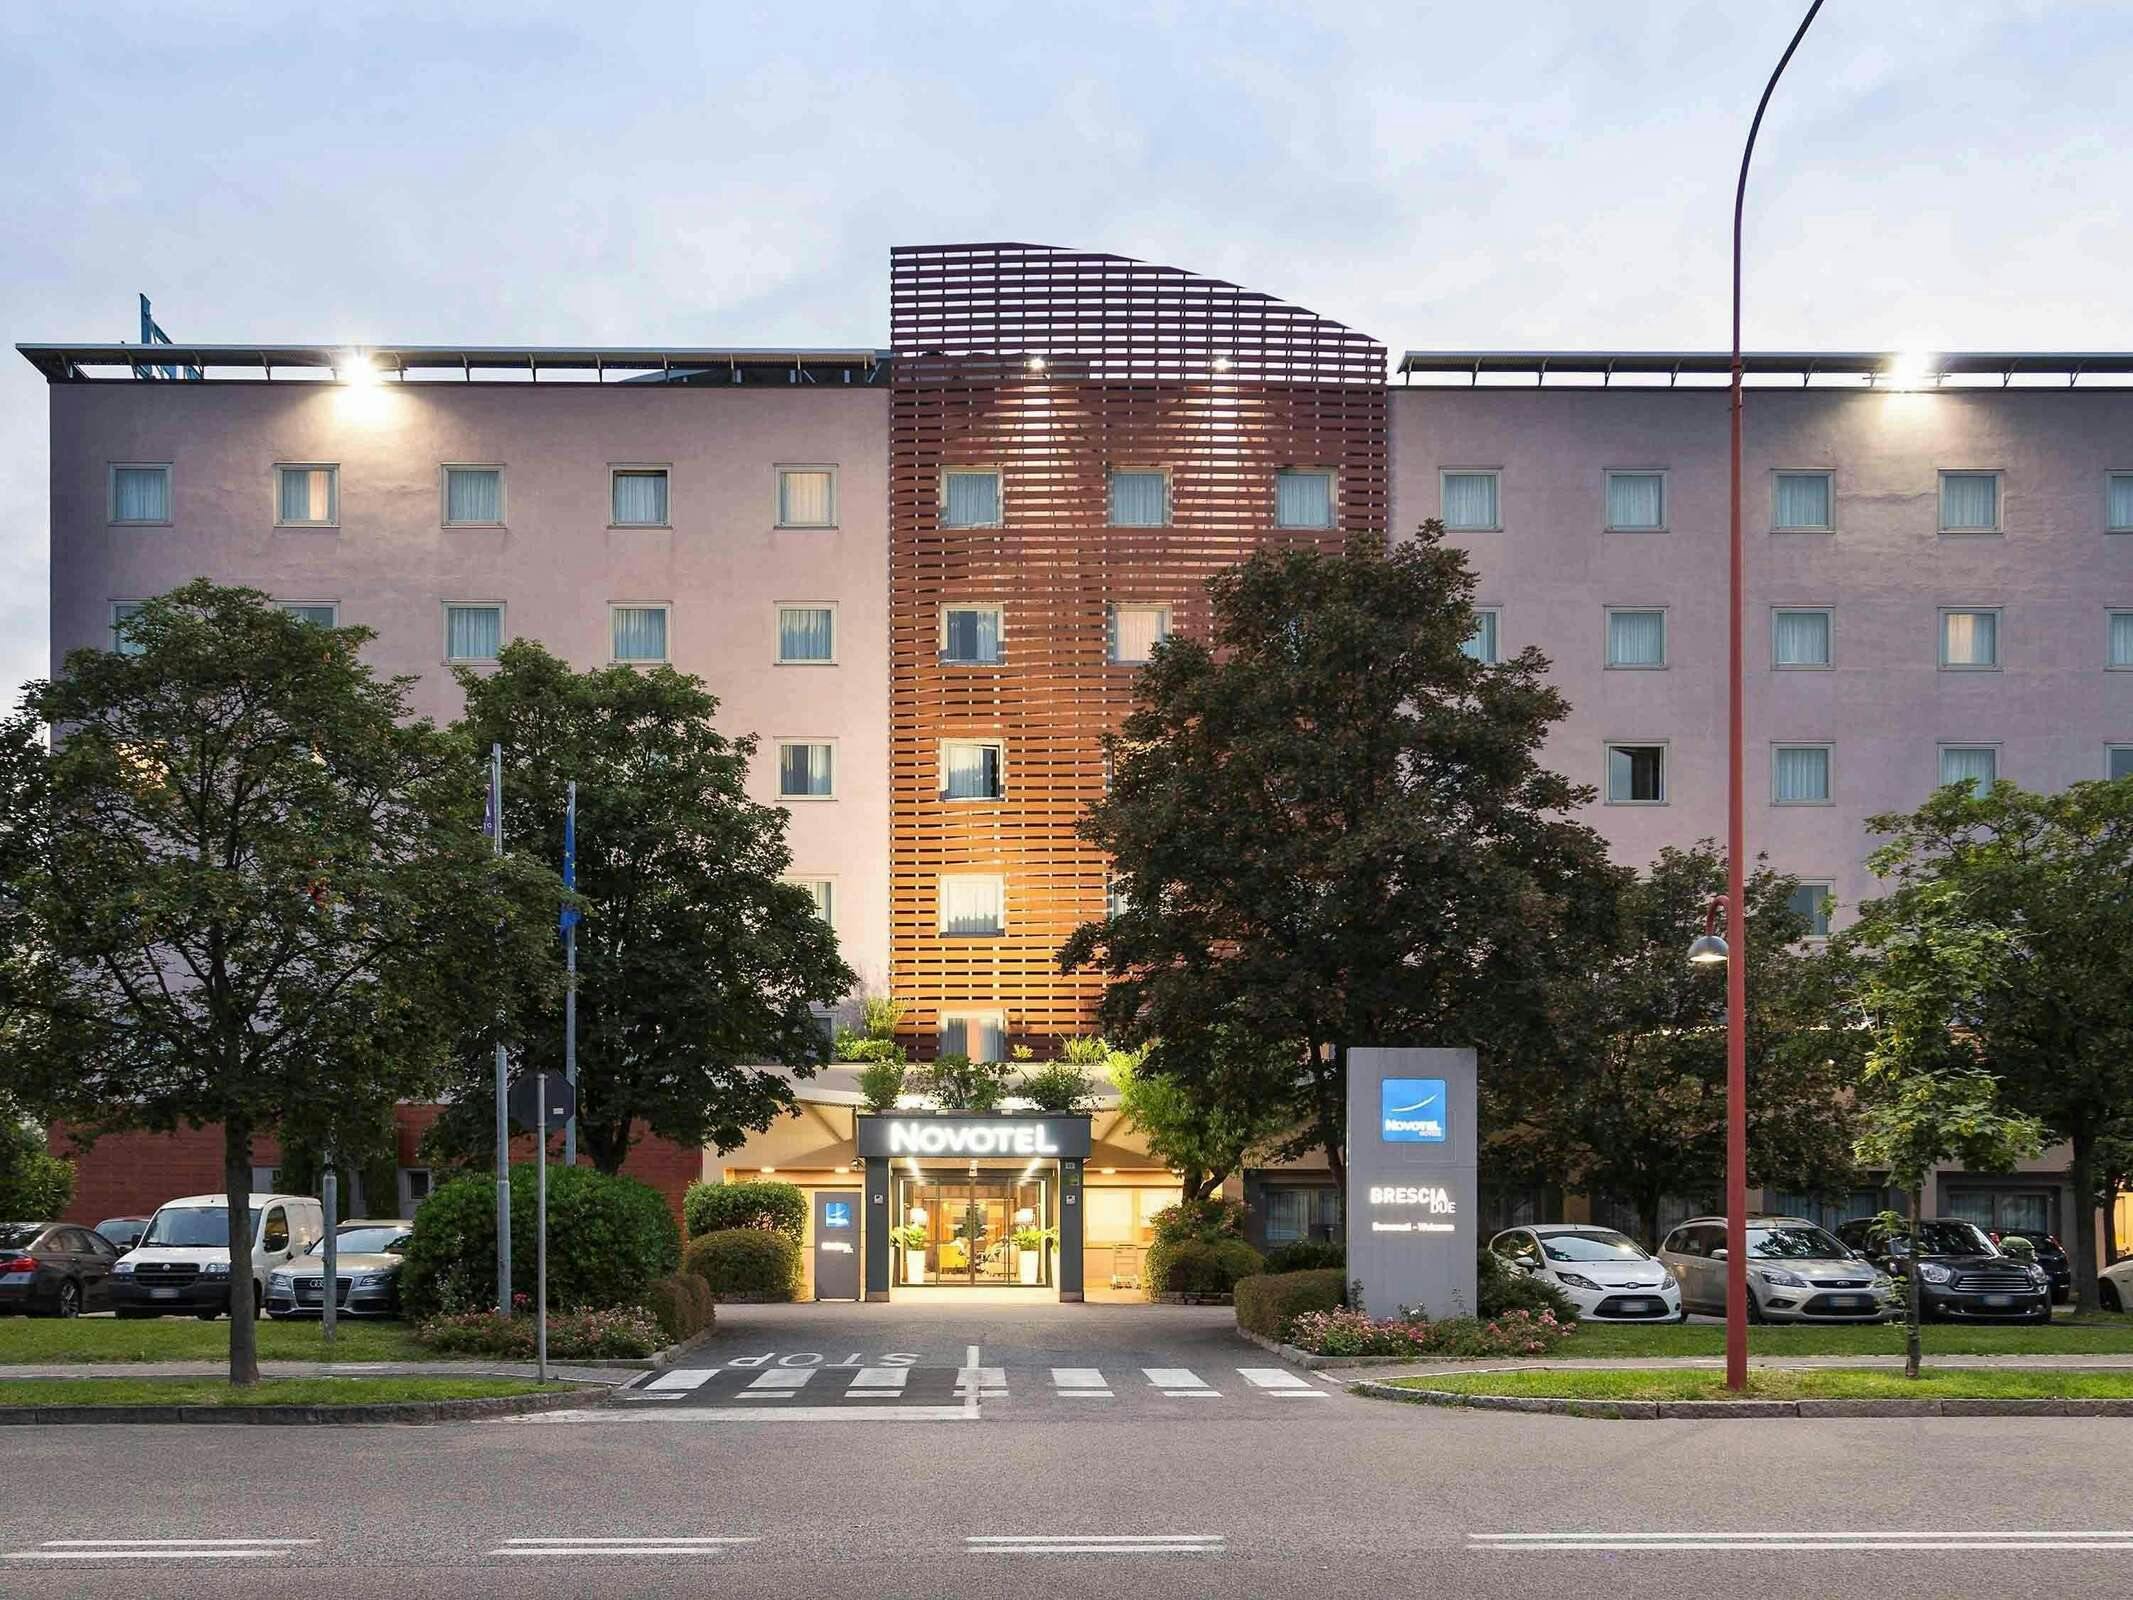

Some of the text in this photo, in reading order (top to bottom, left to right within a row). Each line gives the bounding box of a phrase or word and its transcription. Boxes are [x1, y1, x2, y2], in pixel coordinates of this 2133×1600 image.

[889, 1121, 1058, 1153] NOVOTEL
[1370, 1187, 1448, 1204] BRESCIA
[1430, 1200, 1456, 1213] DUE
[728, 1352, 922, 1367] STOP
